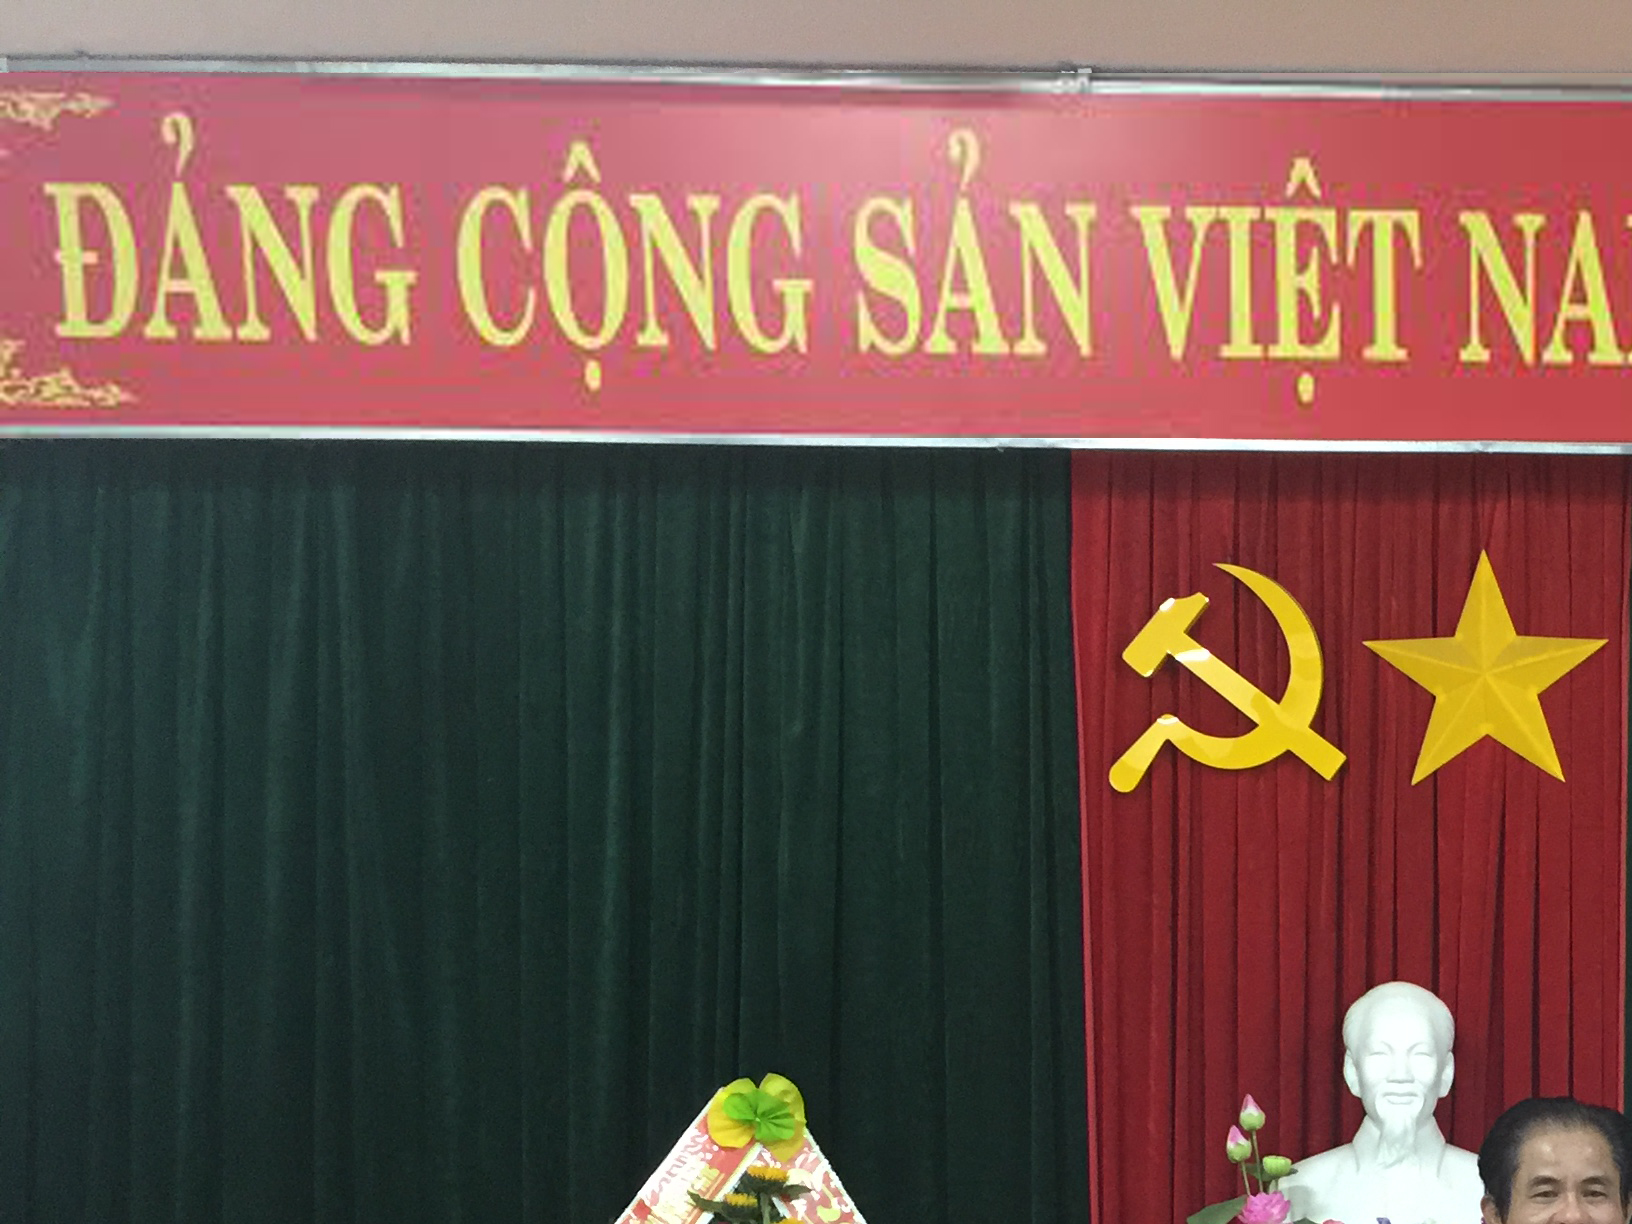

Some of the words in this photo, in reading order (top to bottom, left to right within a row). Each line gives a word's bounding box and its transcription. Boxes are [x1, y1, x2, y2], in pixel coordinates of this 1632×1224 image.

[43, 112, 418, 344] ĐẢNG
[456, 140, 814, 392] CỘNG
[852, 128, 1097, 357] SẢN
[1130, 156, 1422, 403] VIỆT
